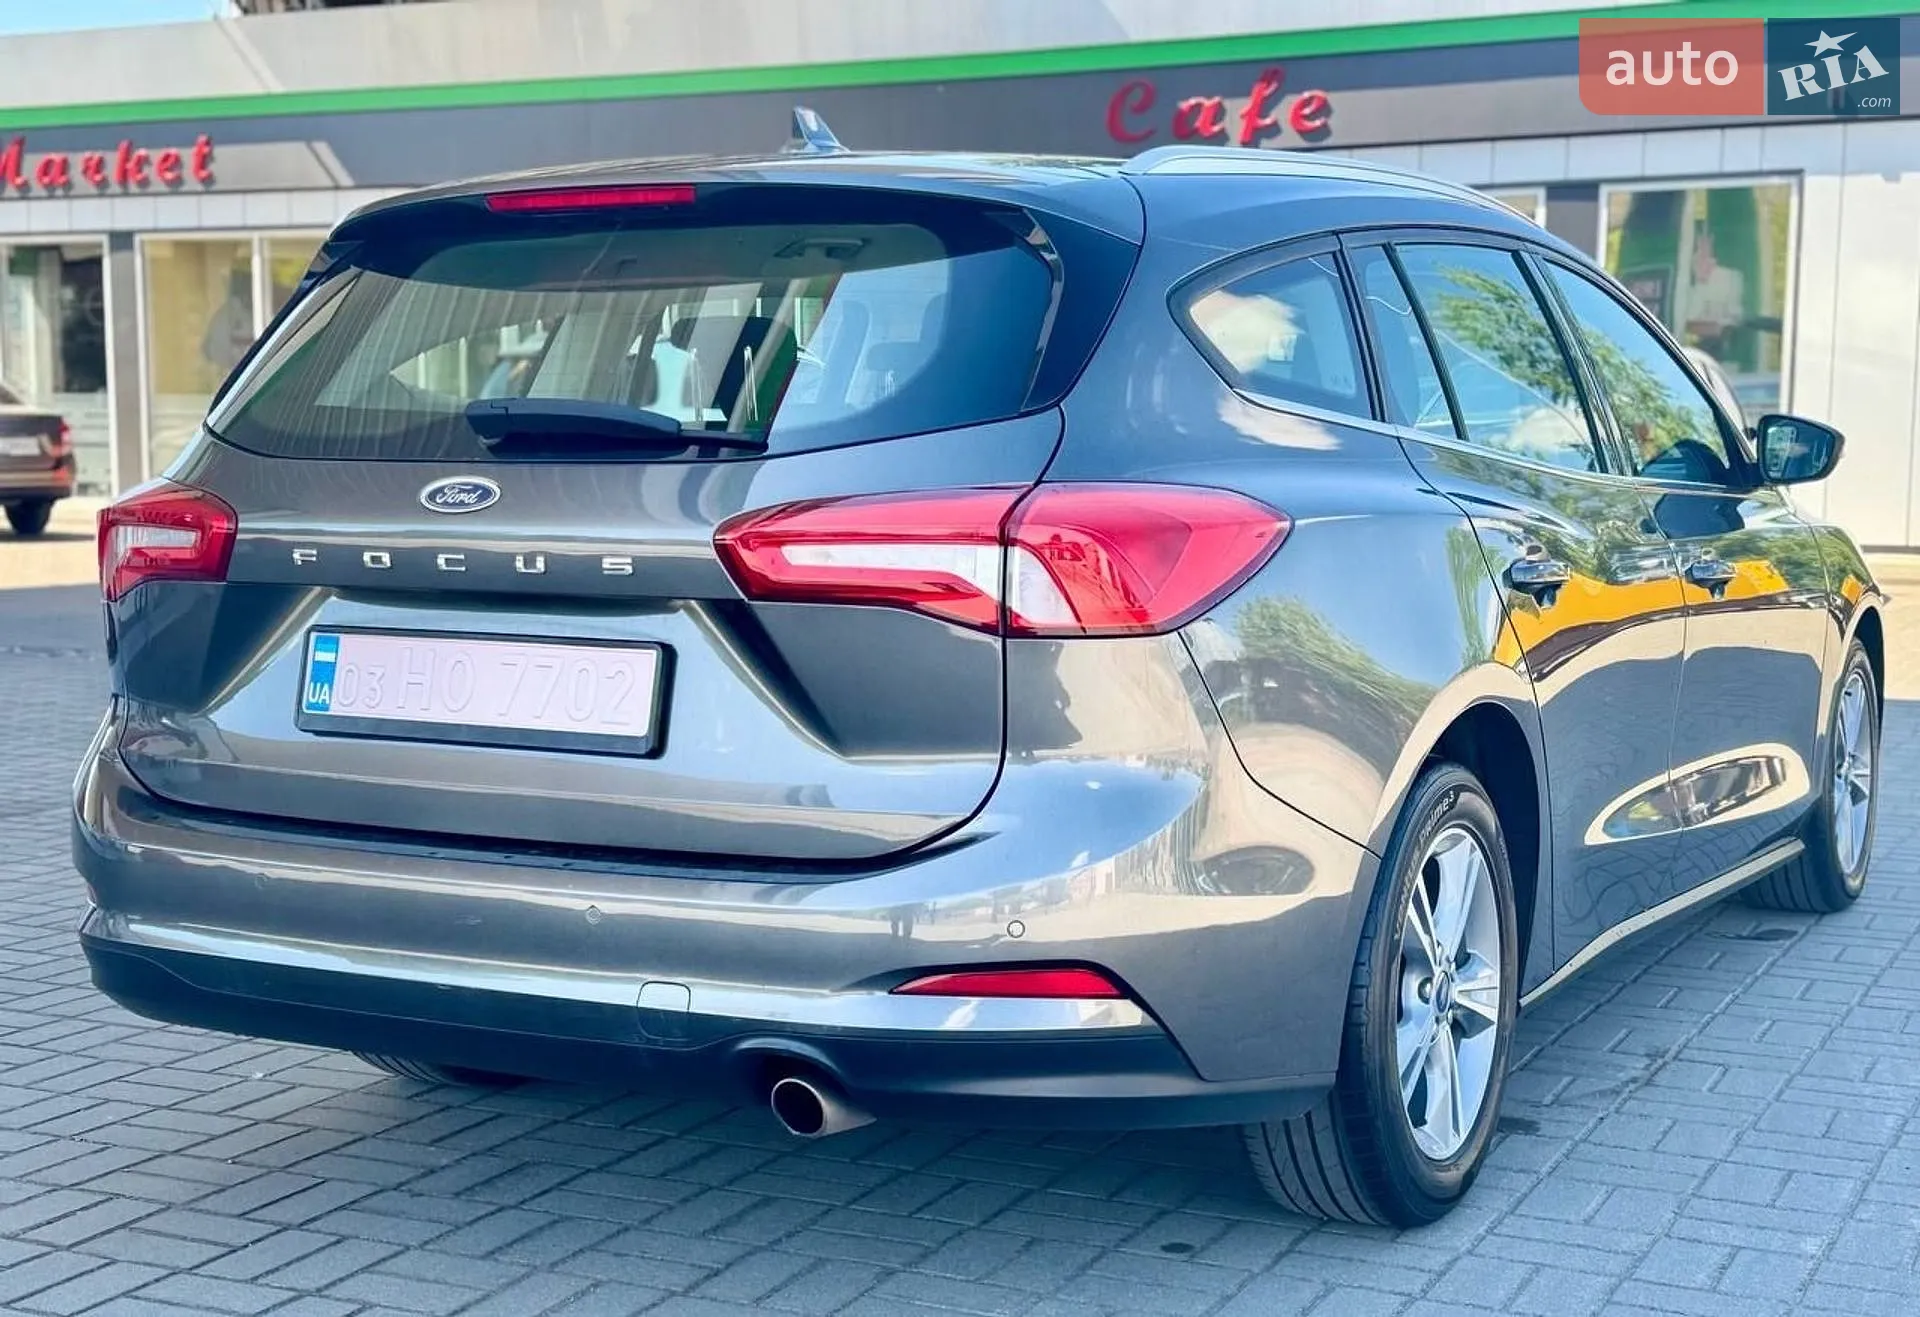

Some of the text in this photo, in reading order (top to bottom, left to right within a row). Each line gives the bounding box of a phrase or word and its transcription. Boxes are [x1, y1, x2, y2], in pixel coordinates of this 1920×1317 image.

[1106, 66, 1330, 146] Cafe
[435, 484, 482, 504] Ford
[292, 548, 635, 576] FOCUS
[308, 681, 332, 706] UA
[338, 664, 385, 710] 03
[498, 652, 637, 727] 7702
